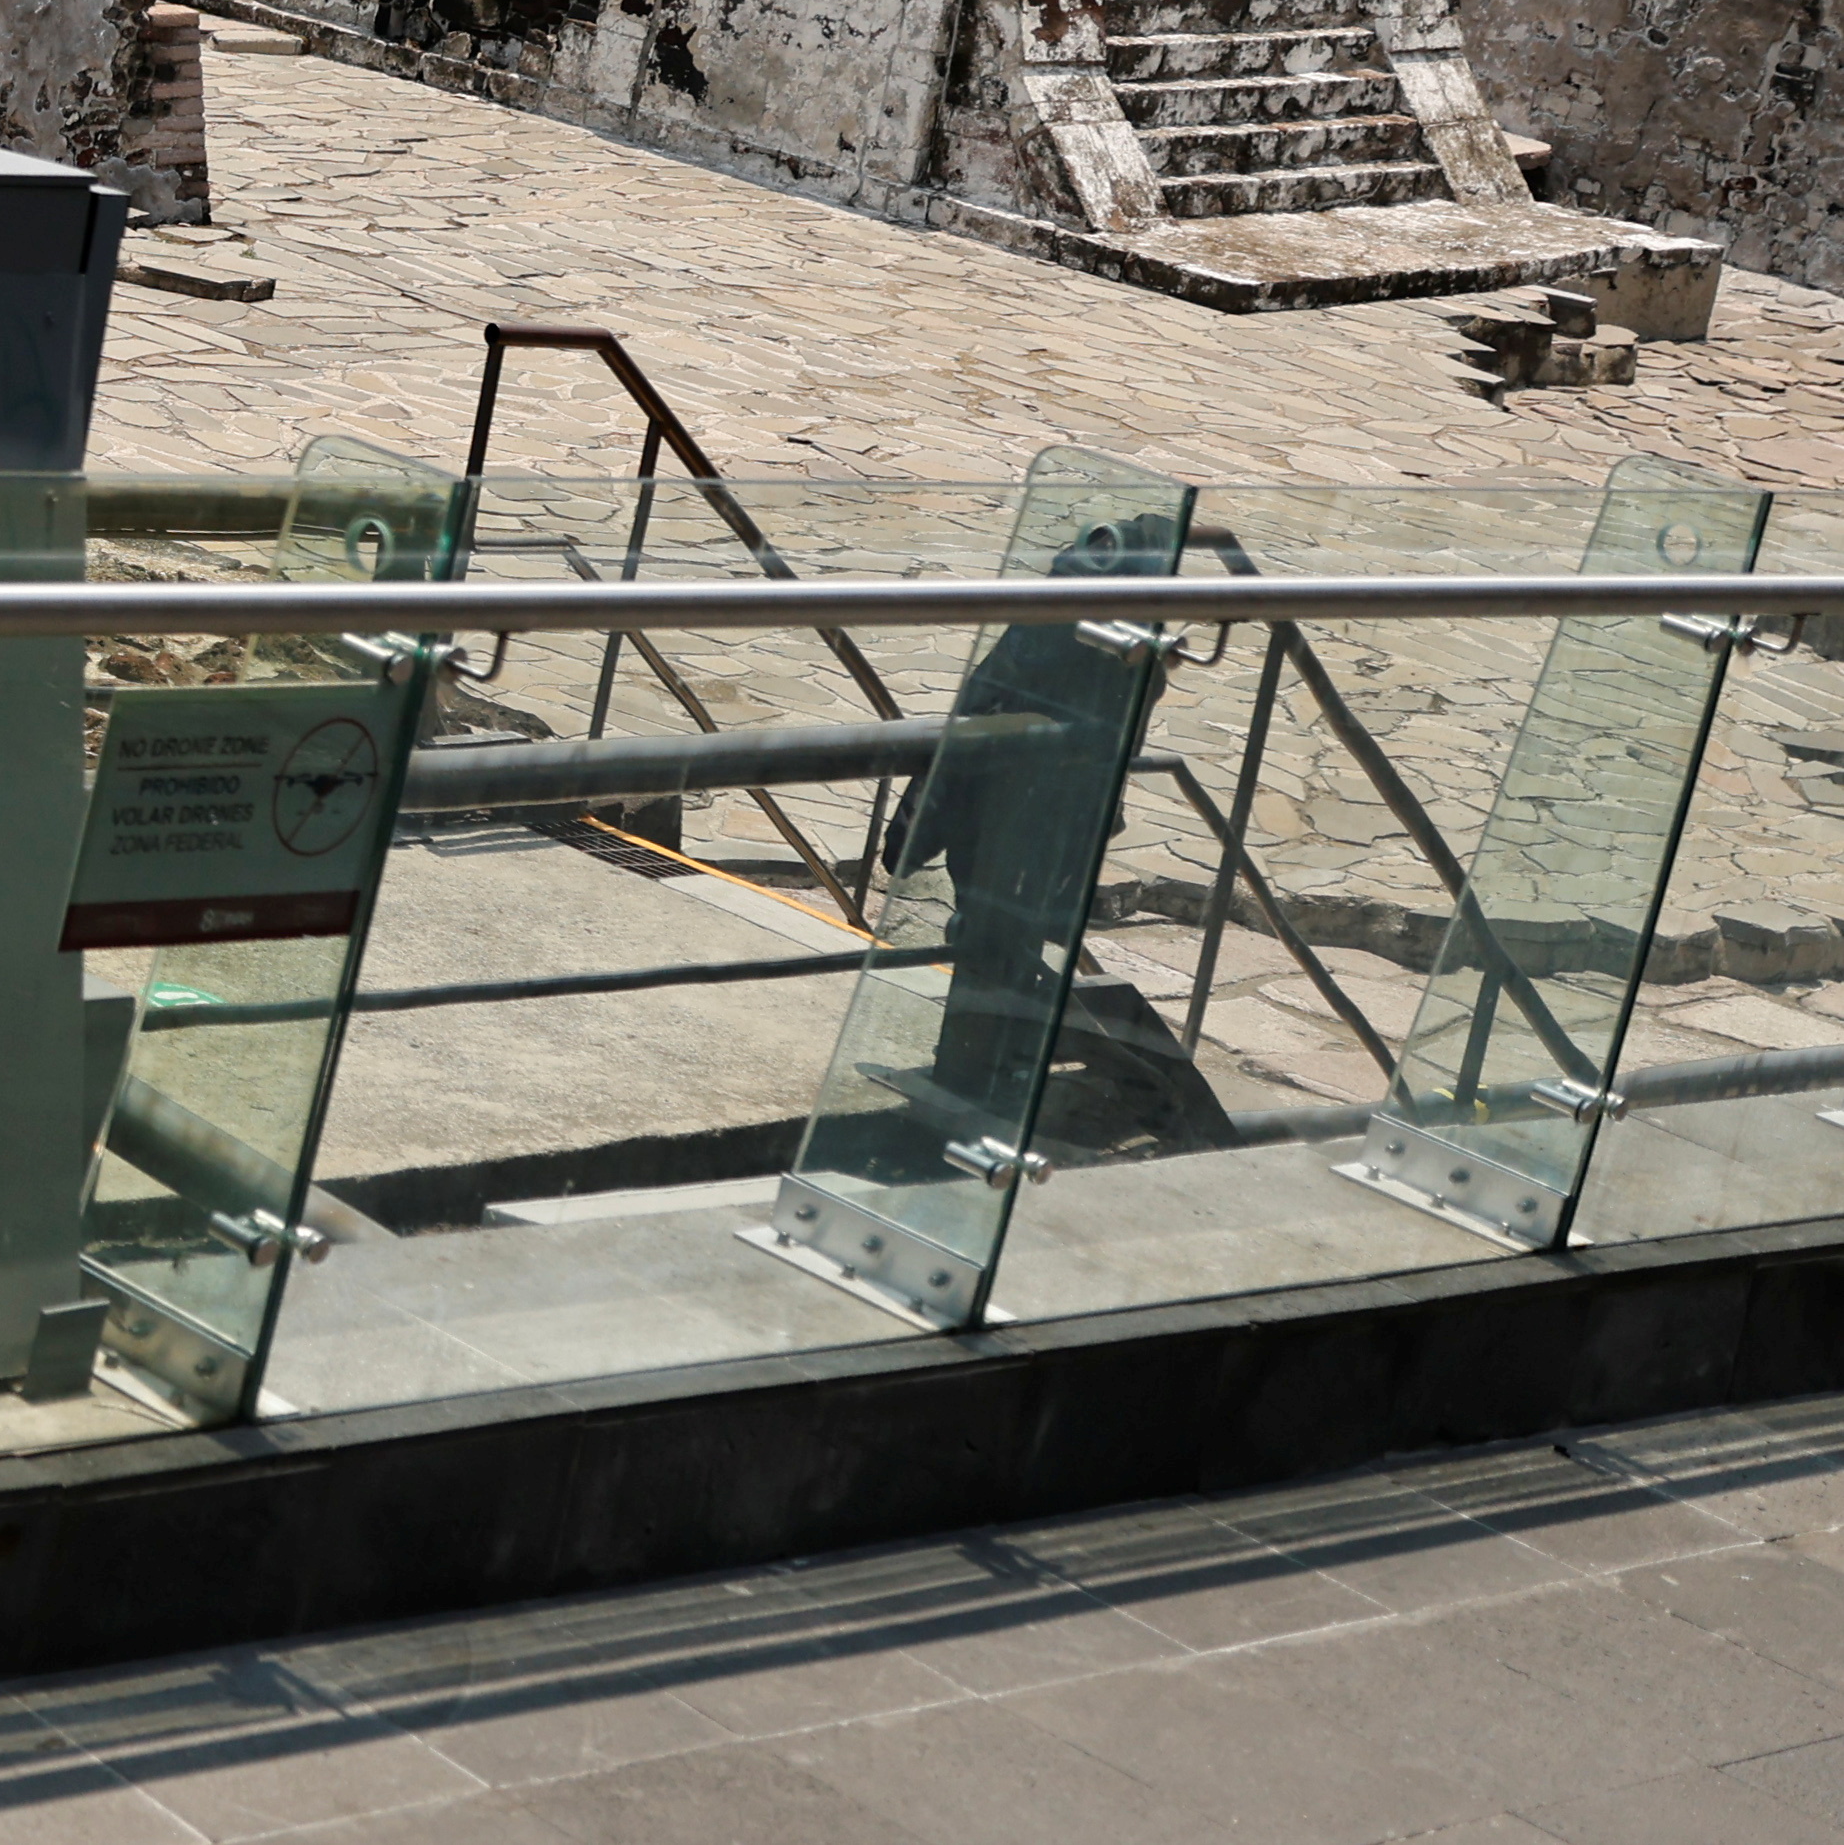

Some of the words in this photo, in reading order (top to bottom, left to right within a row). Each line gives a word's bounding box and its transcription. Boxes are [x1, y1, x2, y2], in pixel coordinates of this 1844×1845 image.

[119, 738, 147, 758] NO
[151, 736, 216, 757] DRONE
[219, 735, 270, 755] ZONE
[138, 775, 241, 796] PROHIBIDO
[112, 805, 175, 826] VOLAR
[178, 802, 254, 824] DRONES
[109, 834, 161, 855] ZONA
[165, 831, 244, 853] FEDERAL
